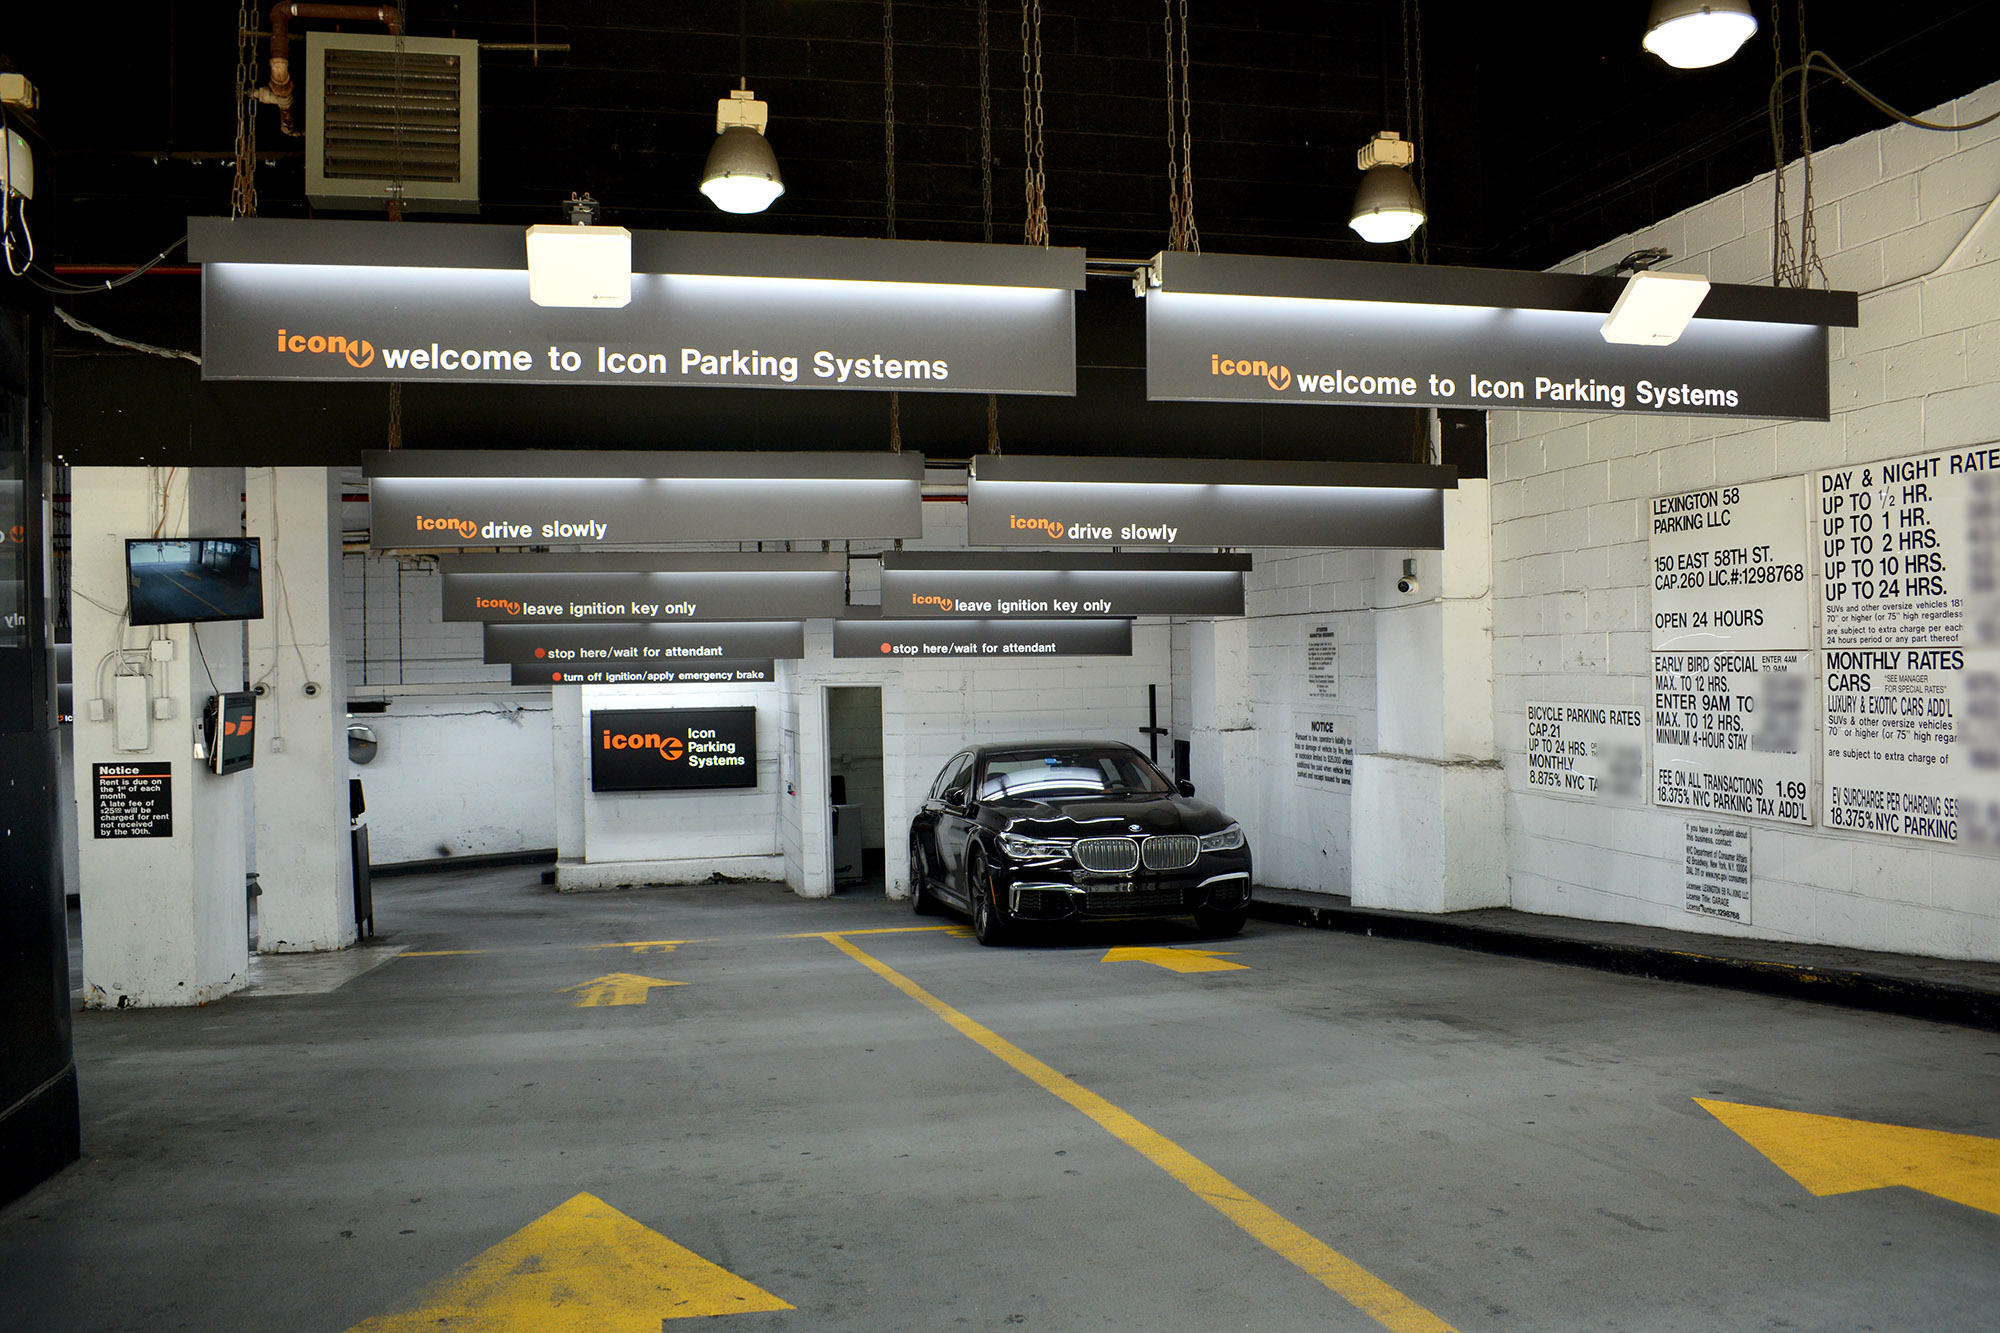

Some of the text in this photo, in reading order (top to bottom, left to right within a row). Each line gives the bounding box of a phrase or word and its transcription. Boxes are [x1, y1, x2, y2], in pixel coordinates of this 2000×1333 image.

[277, 329, 949, 383] icon welcome to Icon Parking Systems
[1211, 354, 1739, 408] icon welcome to Icon Parking Systems
[1822, 472, 1852, 493] DAY
[1862, 469, 1873, 487] &
[1883, 458, 1940, 484] NIGHT
[1653, 488, 1740, 515] LEXINGTON 58
[1823, 496, 1843, 515] UP
[1850, 492, 1871, 511] TO
[1903, 484, 1932, 504] HR.
[416, 516, 607, 540] icon drive slowly
[1010, 515, 1177, 543] icon drive slowly
[1654, 509, 1731, 534] PARKING LLC
[1823, 507, 1930, 536] UP TO 1 HR.
[1824, 529, 1940, 558] UP TO 2 HRS.
[1654, 546, 1773, 572] 150 EAST 58TH ST.
[1825, 552, 1946, 580] UP TO 10 HRS.
[1655, 572, 1704, 590] CAP.260
[1826, 576, 1947, 601] UP TO 24 HRS.
[476, 597, 696, 617] icon leave ignition key only
[912, 593, 1111, 614] icon leave ignition key only
[1655, 609, 1764, 628] OPEN 24 HOURS
[892, 642, 1056, 656] stop here/wait for attendant
[1860, 636, 1882, 644] period
[1911, 635, 1927, 643] part
[1930, 634, 1959, 642] thereof
[547, 646, 723, 660] stop here/wait for attendant
[1827, 650, 1964, 670] MONTHLY RATES
[1655, 656, 1758, 672] EARLY BIRD SPECIAL
[563, 670, 765, 683] turn off ignition/apply emergency brake
[1828, 674, 1871, 692] CARS
[1528, 706, 1640, 726] BICYCLE PARKING RATES
[688, 728, 716, 739] Icon
[1311, 721, 1333, 733] NOTICE
[1529, 722, 1560, 738] CAP.21
[603, 730, 660, 750] icon
[688, 741, 736, 754] Parking
[1529, 738, 1539, 752] UP
[1542, 739, 1552, 753] TO
[1555, 740, 1565, 754] 24
[1568, 741, 1588, 756] HRS.
[100, 766, 140, 774] Notice
[688, 755, 745, 768] Systems
[1529, 754, 1574, 771] MONTHLY
[1659, 769, 1806, 800] FEE ON ALL TRANSACTIONS 1.69
[1657, 787, 1807, 821] 18.375% NYC PARKING TAX ADD'L
[1830, 807, 1957, 840] 18.375% NYC PARKING
